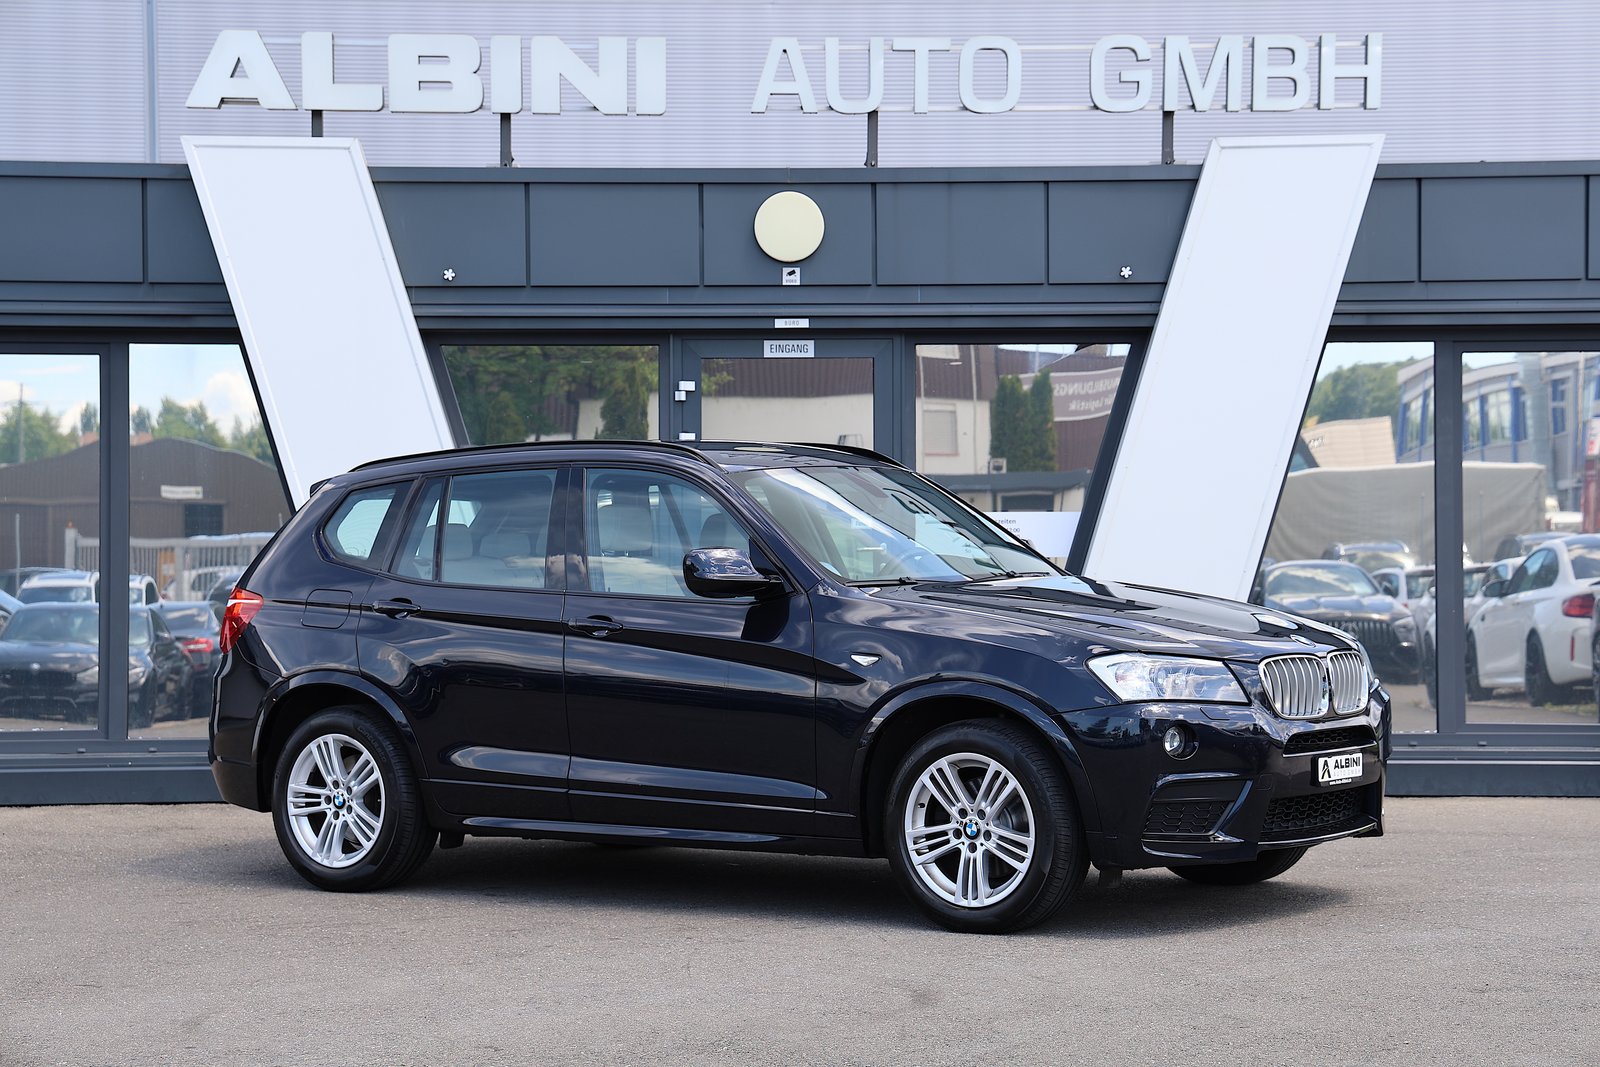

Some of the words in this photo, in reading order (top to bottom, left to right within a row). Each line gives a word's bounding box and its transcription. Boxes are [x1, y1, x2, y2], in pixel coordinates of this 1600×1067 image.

[185, 30, 667, 115] ALBINI
[751, 35, 1022, 114] AUTO
[1090, 32, 1384, 113] GMBH
[769, 343, 809, 354] EINGANG
[1334, 756, 1361, 770] ALBINI
